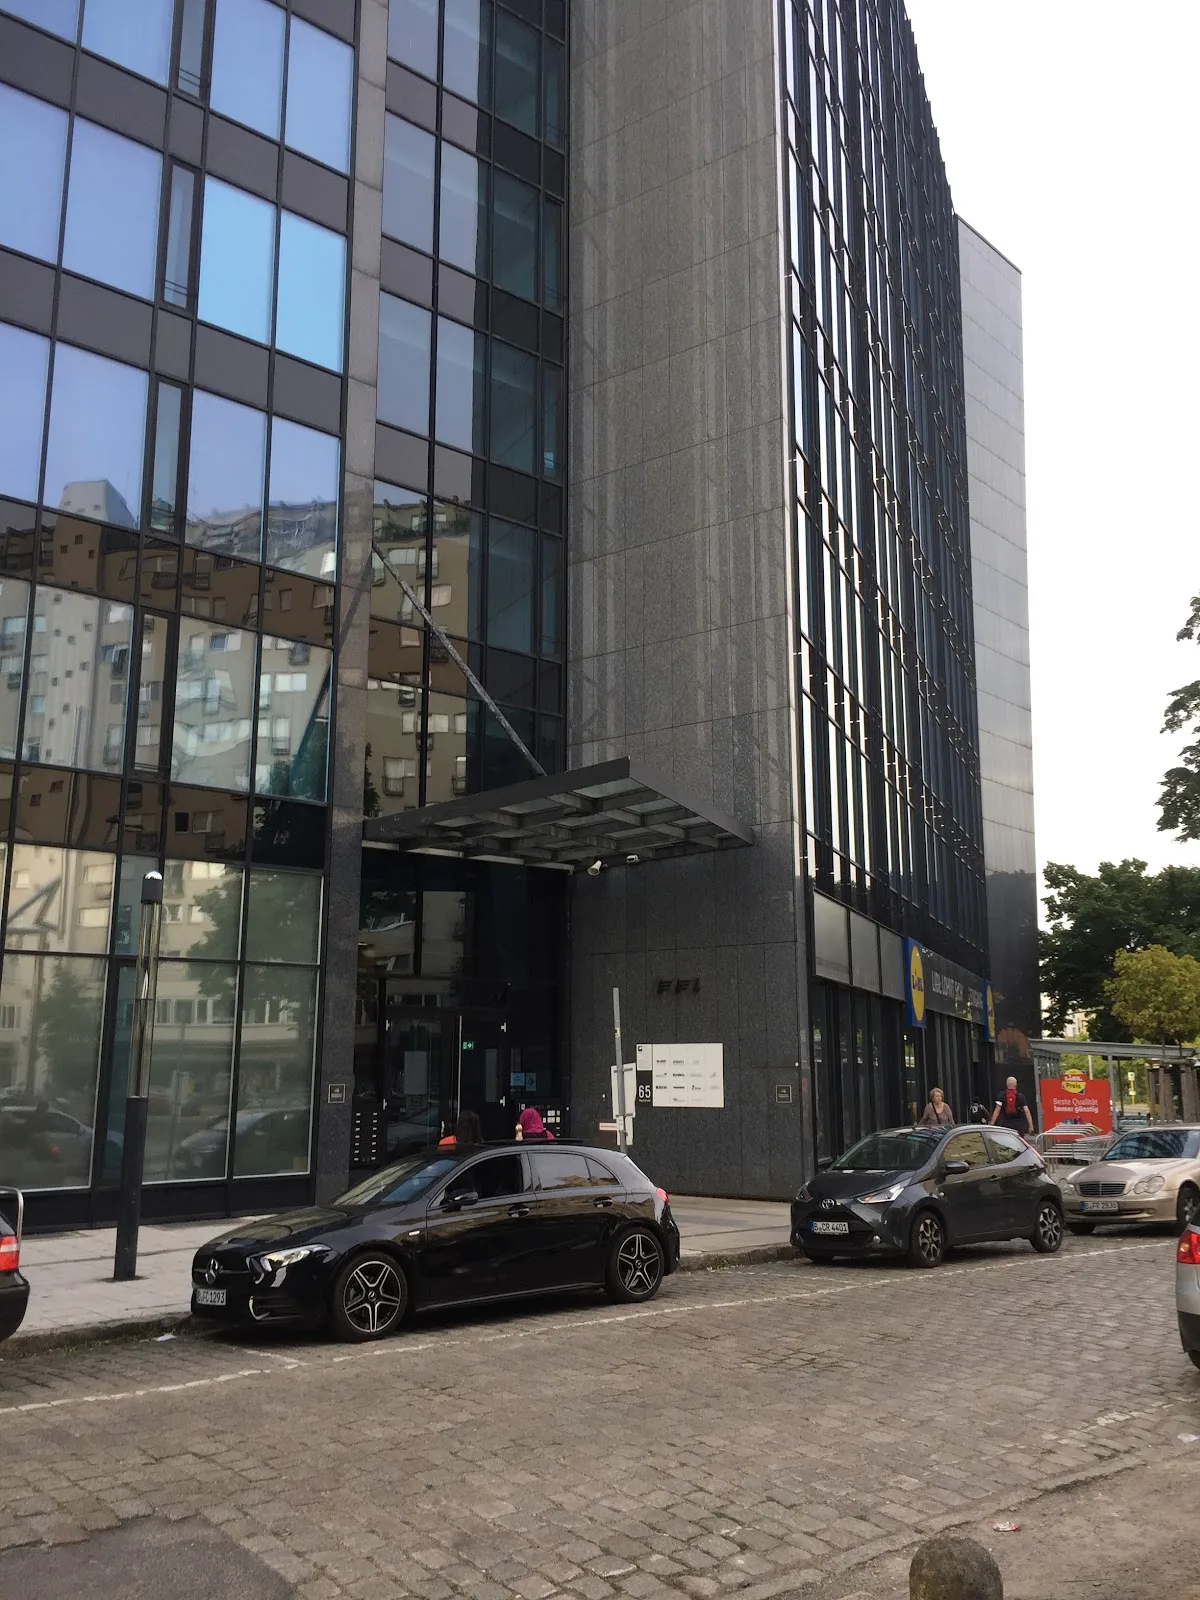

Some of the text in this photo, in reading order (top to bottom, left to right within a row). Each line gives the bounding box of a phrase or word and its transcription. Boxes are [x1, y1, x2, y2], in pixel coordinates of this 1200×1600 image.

[638, 1085, 651, 1099] 65
[1053, 1098, 1071, 1106] Beste
[1074, 1106, 1099, 1114] günstig
